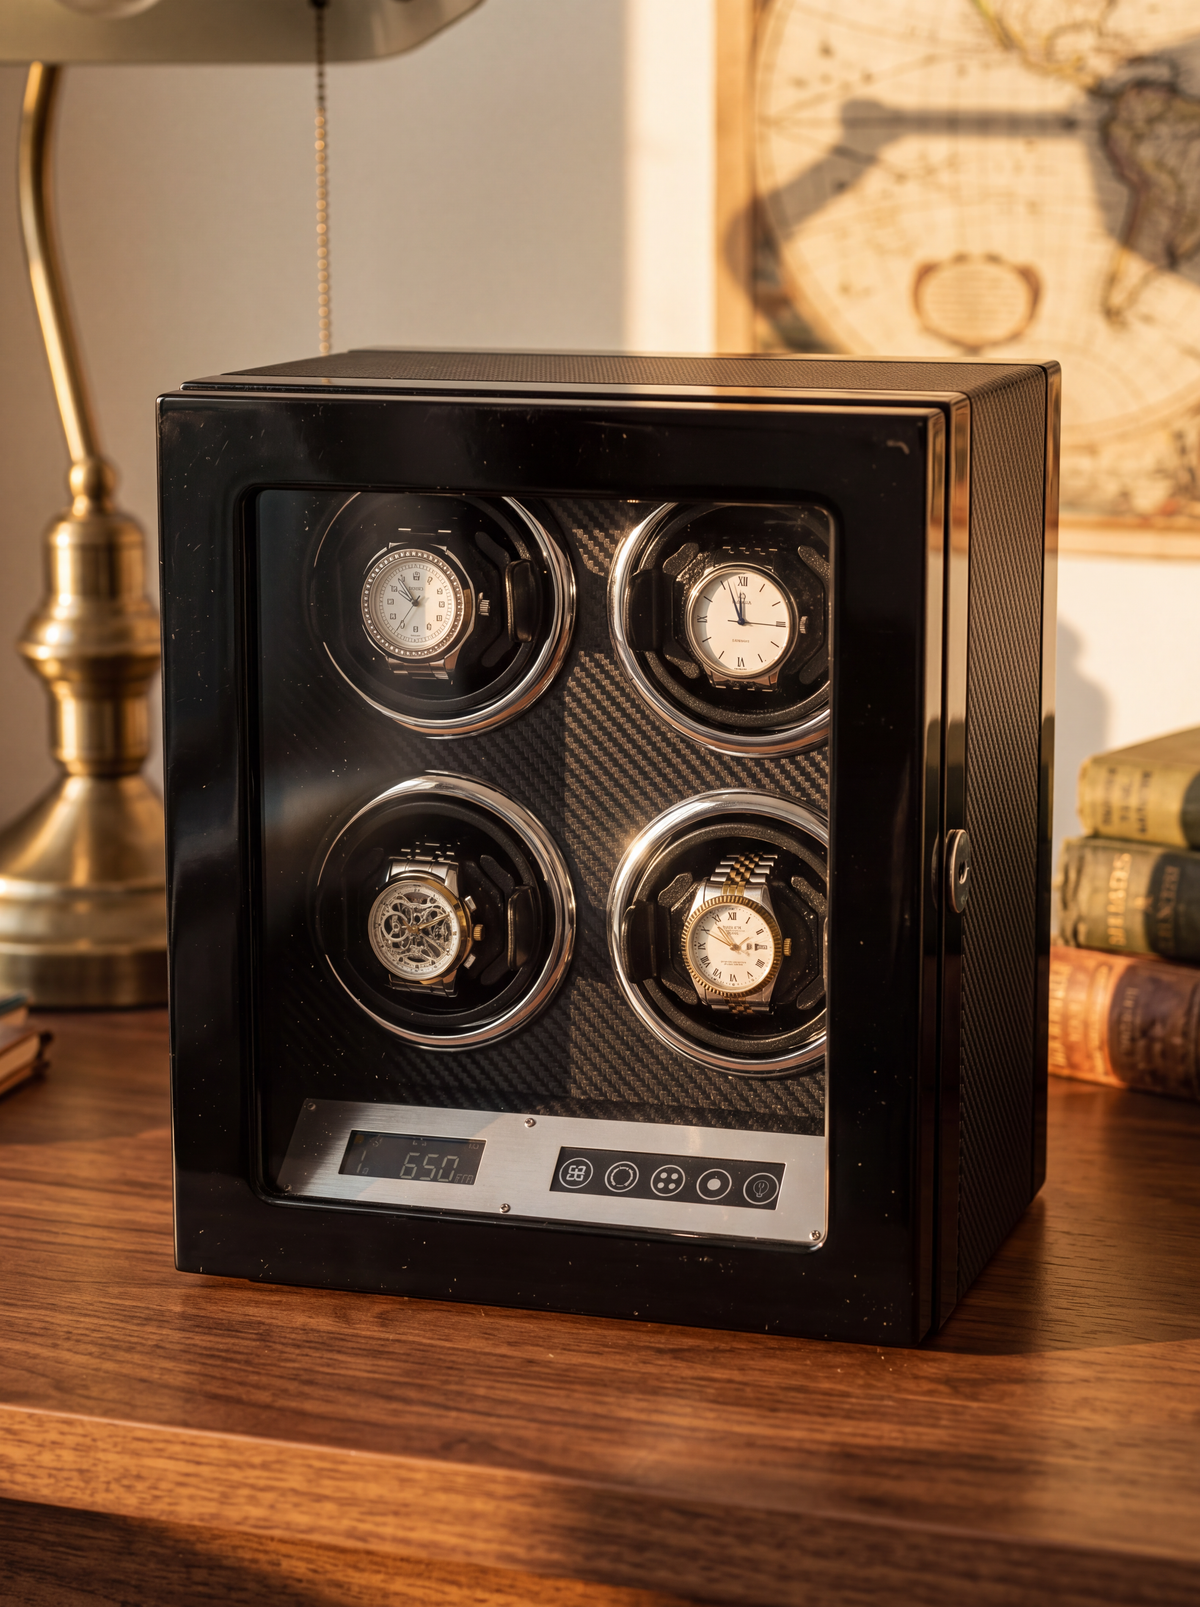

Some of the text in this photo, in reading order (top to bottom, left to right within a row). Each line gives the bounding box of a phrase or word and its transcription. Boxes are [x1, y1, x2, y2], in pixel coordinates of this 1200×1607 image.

[738, 576, 748, 587] XII
[728, 912, 737, 921] XII
[755, 928, 765, 936] II
[712, 967, 722, 979] VII
[729, 973, 738, 983] VI
[399, 1152, 460, 1182] 650
